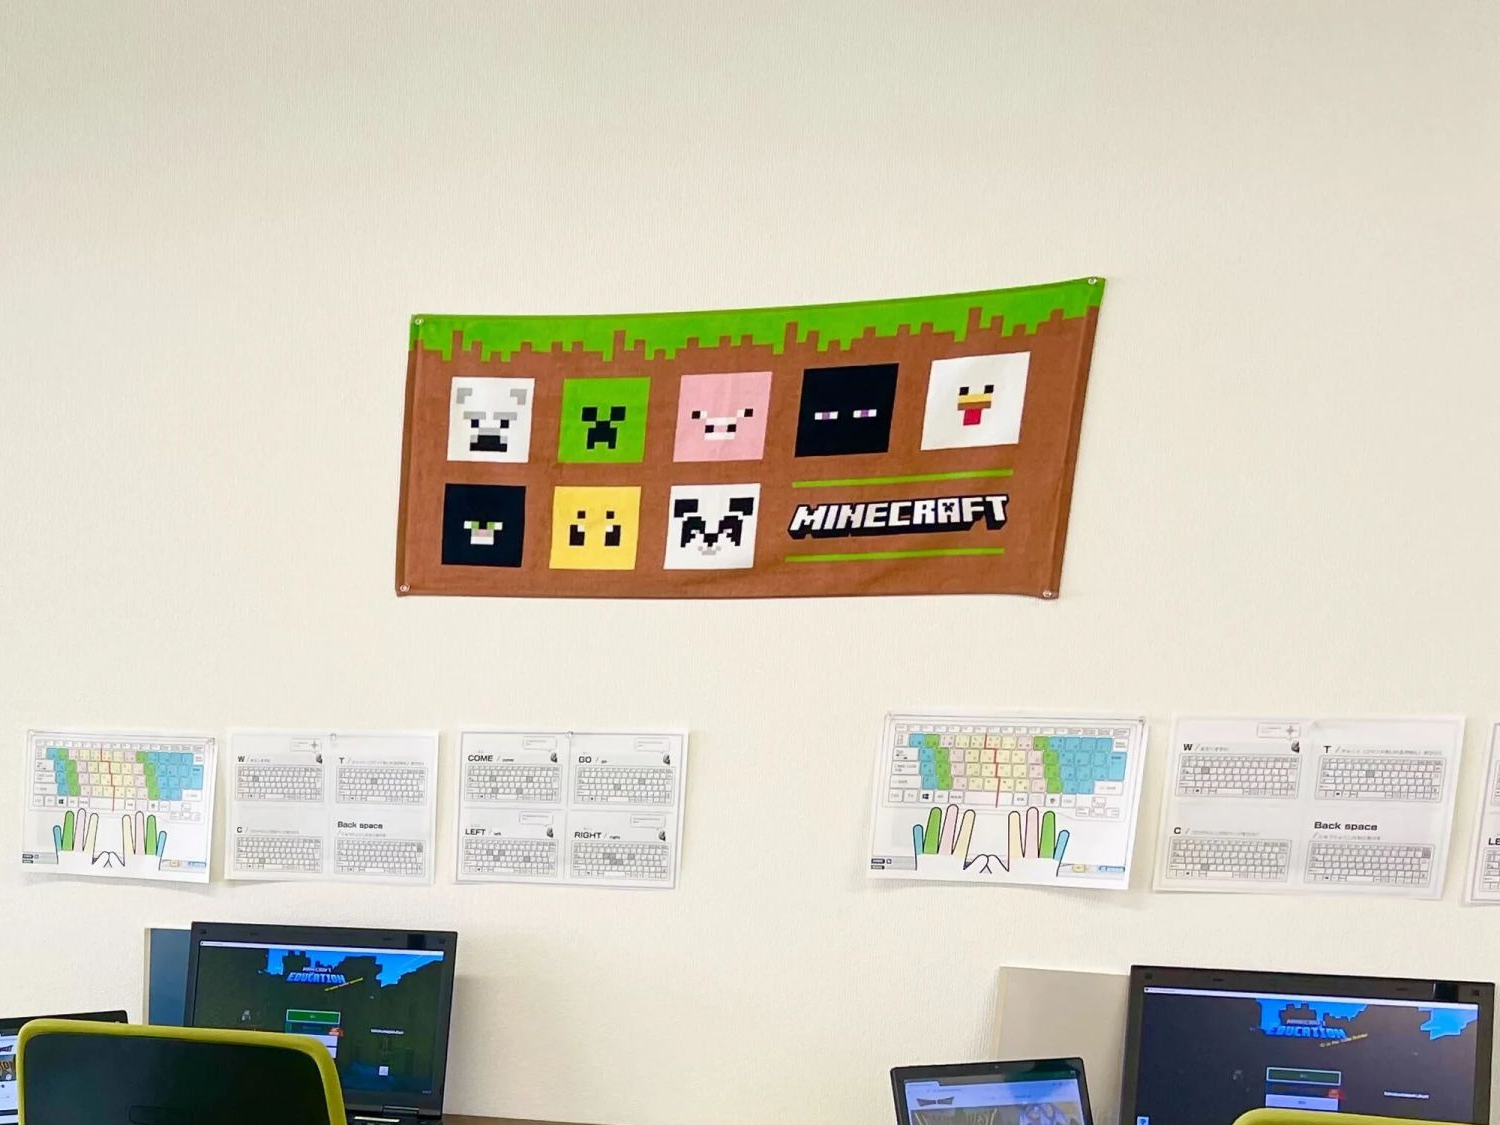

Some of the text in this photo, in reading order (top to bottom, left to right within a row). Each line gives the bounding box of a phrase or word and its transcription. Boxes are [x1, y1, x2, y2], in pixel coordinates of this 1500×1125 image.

[788, 494, 1009, 539] MINECRAFT
[1183, 743, 1193, 751] W
[1324, 745, 1332, 754] T
[238, 755, 245, 763] W
[467, 754, 493, 762] COME
[578, 756, 592, 764] GO
[337, 821, 383, 830] Back space
[1314, 822, 1378, 832] Back space
[465, 828, 486, 836] LEFT
[574, 831, 602, 839] RIGHT
[1173, 827, 1182, 835] C
[287, 972, 346, 984] EDUCATION
[1266, 1025, 1347, 1040] EDUCATION
